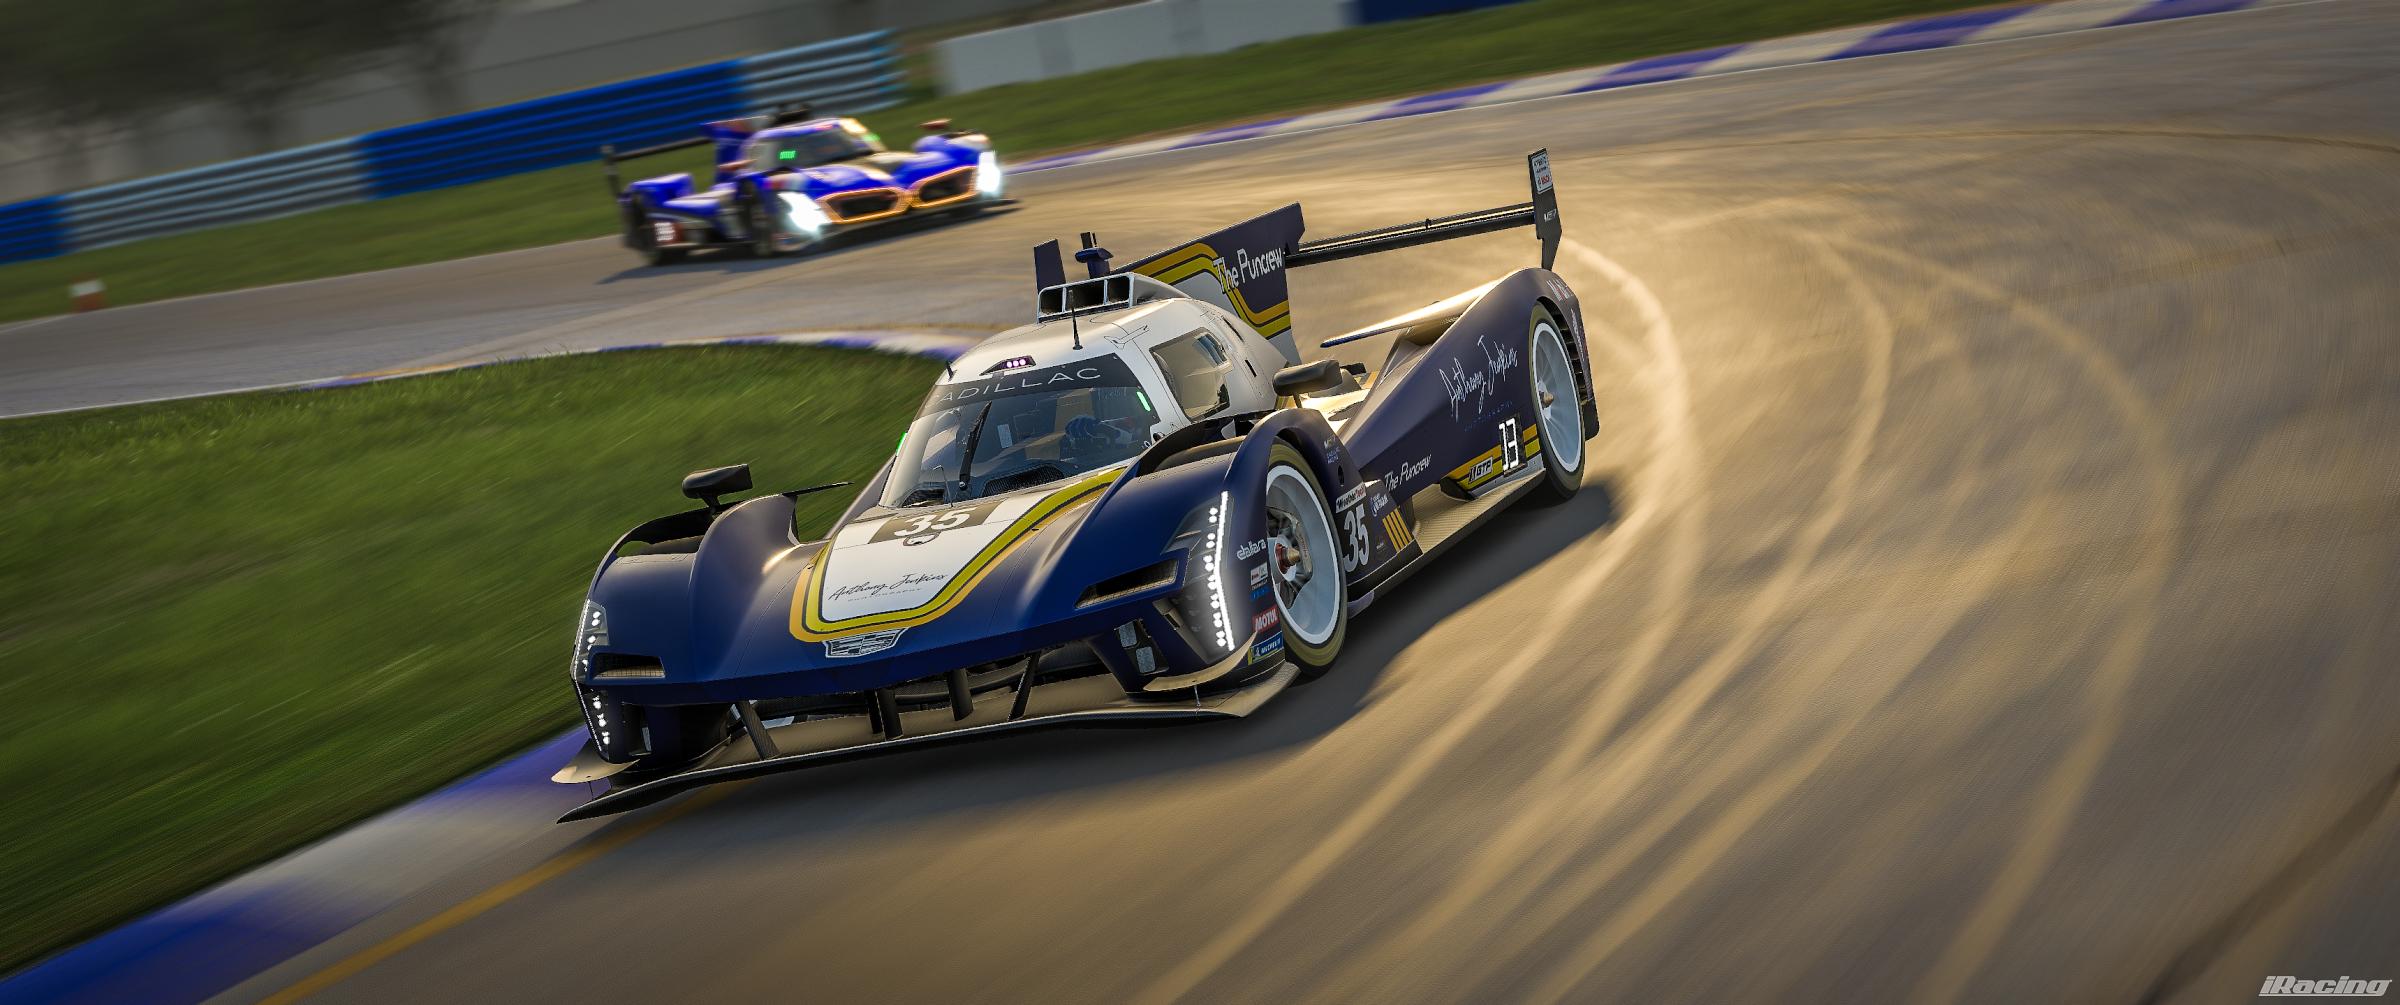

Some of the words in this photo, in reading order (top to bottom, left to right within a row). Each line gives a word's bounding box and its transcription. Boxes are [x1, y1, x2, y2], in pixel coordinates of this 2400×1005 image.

[1213, 257, 1239, 293] The
[1237, 248, 1283, 283] Puncrew
[1498, 417, 1519, 471] 13
[1384, 470, 1399, 491] The
[1399, 454, 1432, 485] Puncrew
[1477, 460, 1492, 477] GTP
[894, 507, 977, 536] 35
[1343, 504, 1369, 572] 35
[828, 581, 889, 601] Anthony
[890, 573, 948, 590] Jenkins
[1255, 608, 1277, 631] MOTUL
